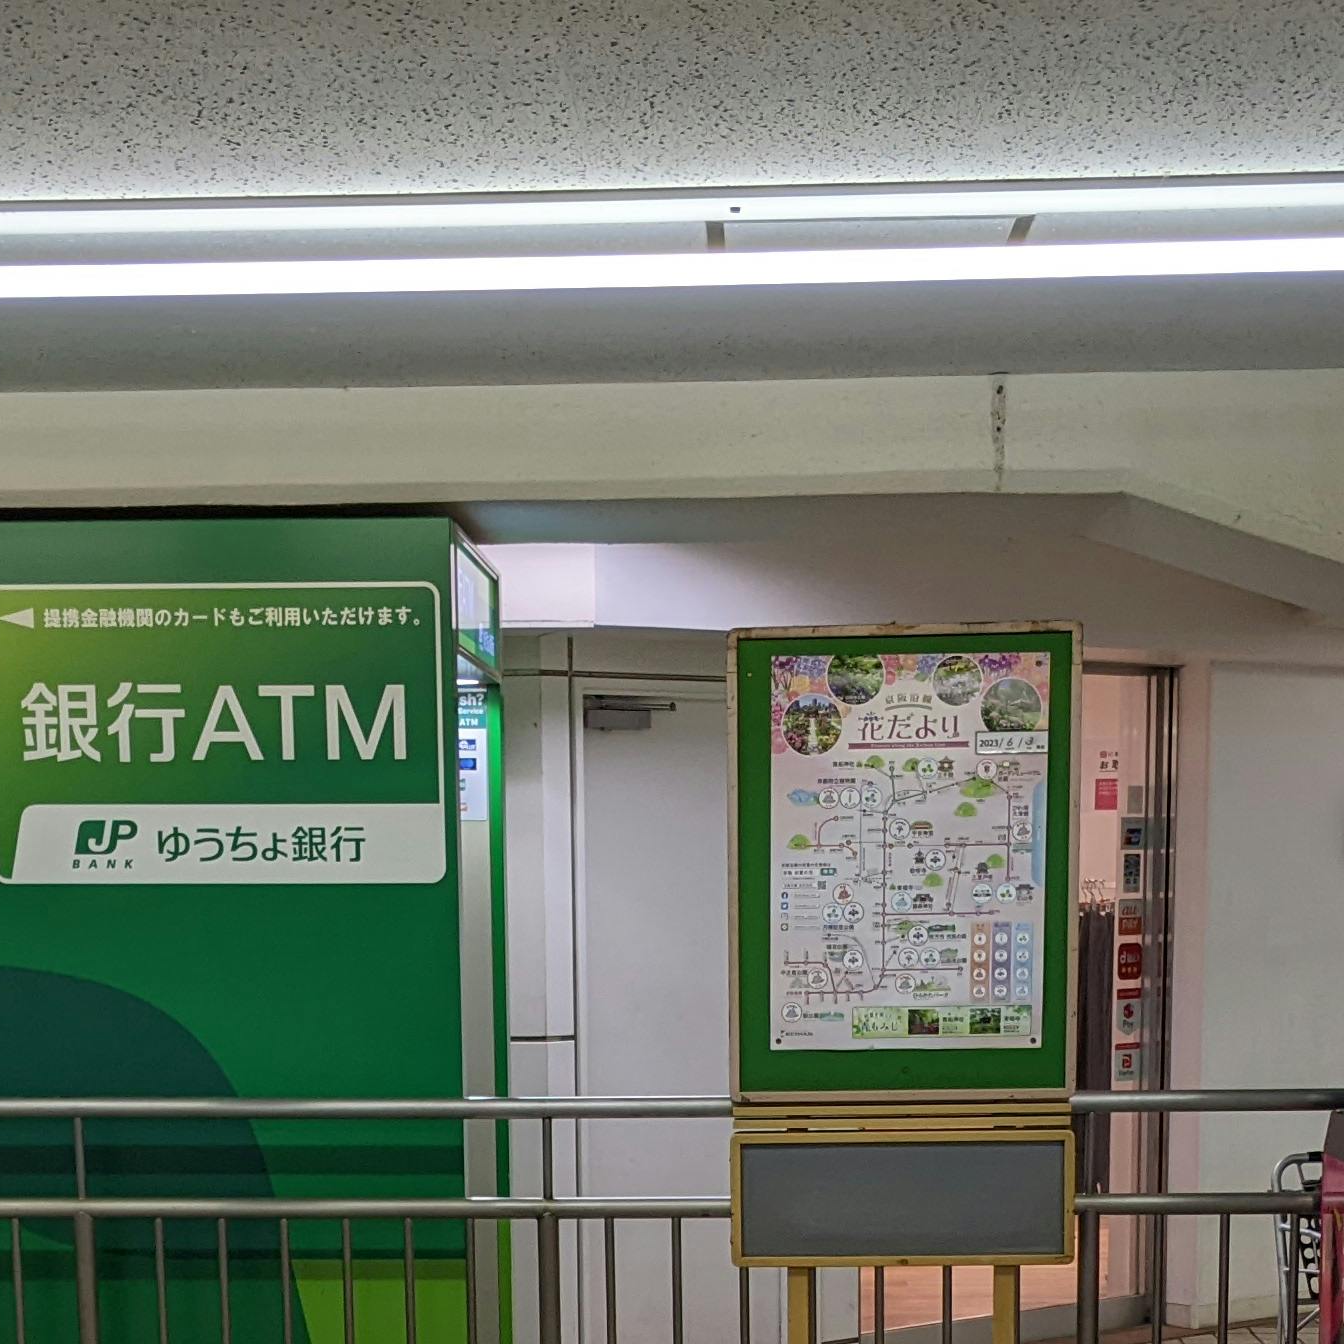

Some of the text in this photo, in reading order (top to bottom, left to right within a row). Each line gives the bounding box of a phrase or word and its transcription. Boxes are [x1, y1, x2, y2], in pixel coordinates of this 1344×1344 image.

[43, 606, 421, 628] 提携金融機関のカードもご利用いただけます。
[20, 681, 408, 763] 銀行ATM
[459, 718, 479, 727] ATM
[858, 712, 960, 741] 花だより
[74, 819, 138, 855] JP
[156, 825, 366, 864] ゆうちょ銀行
[71, 858, 135, 870] BANK
